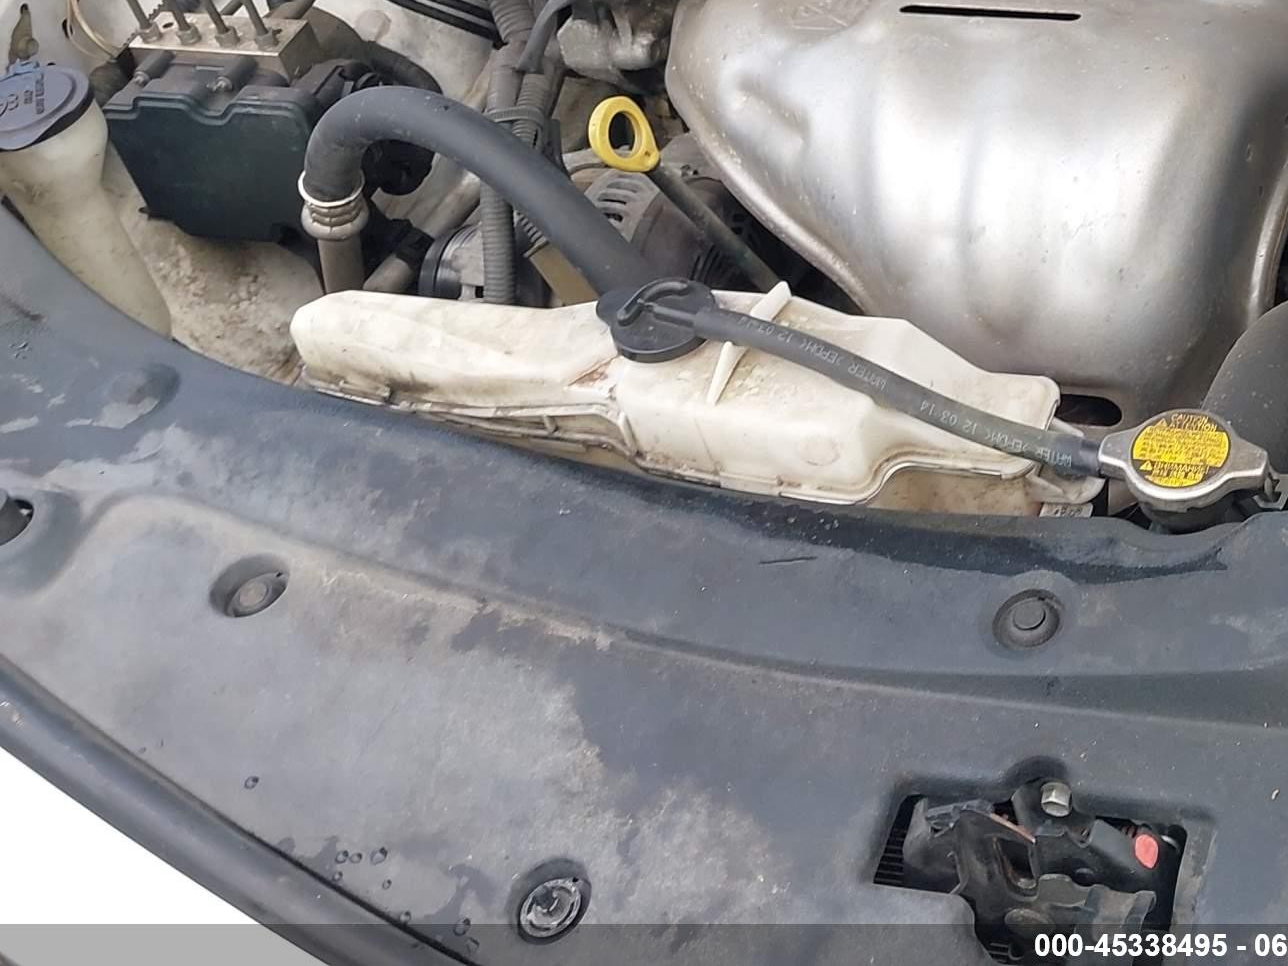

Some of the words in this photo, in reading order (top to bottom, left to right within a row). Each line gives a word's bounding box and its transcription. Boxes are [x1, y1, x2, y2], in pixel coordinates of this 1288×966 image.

[847, 361, 888, 391] WATER
[961, 418, 978, 436] 12
[1036, 446, 1072, 468] WATER
